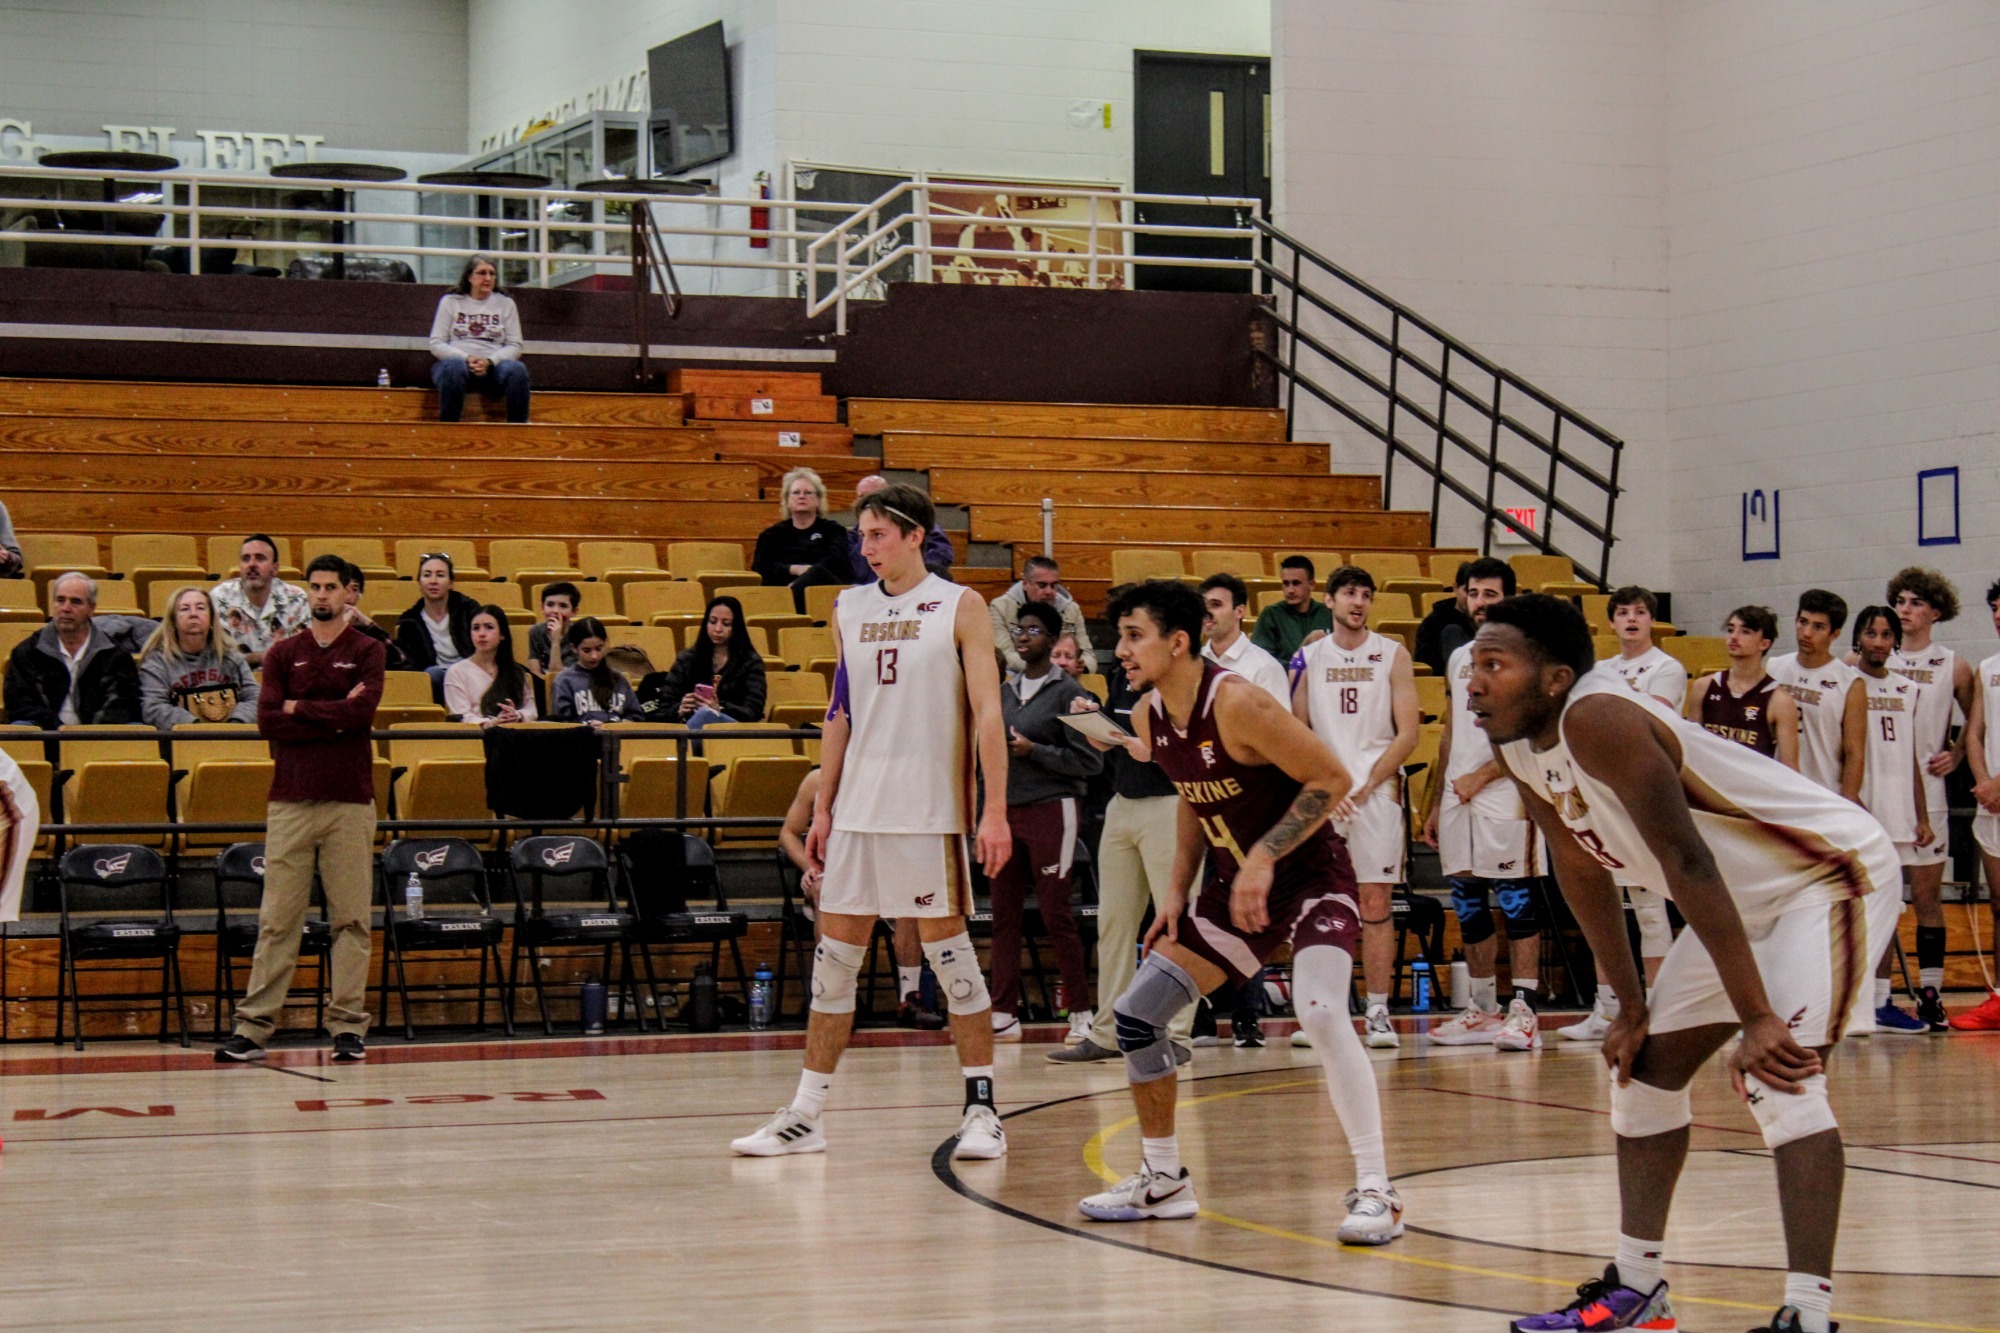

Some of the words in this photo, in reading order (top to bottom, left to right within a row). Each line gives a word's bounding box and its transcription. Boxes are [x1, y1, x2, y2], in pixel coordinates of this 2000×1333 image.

[859, 620, 922, 643] ERSKINE
[876, 648, 898, 686] 13
[1326, 667, 1374, 683] ERSKINE
[1340, 687, 1358, 714] 18
[441, 922, 482, 932] ERSKINE
[580, 918, 620, 927] ERSKINE
[112, 928, 156, 938] ERSKINE
